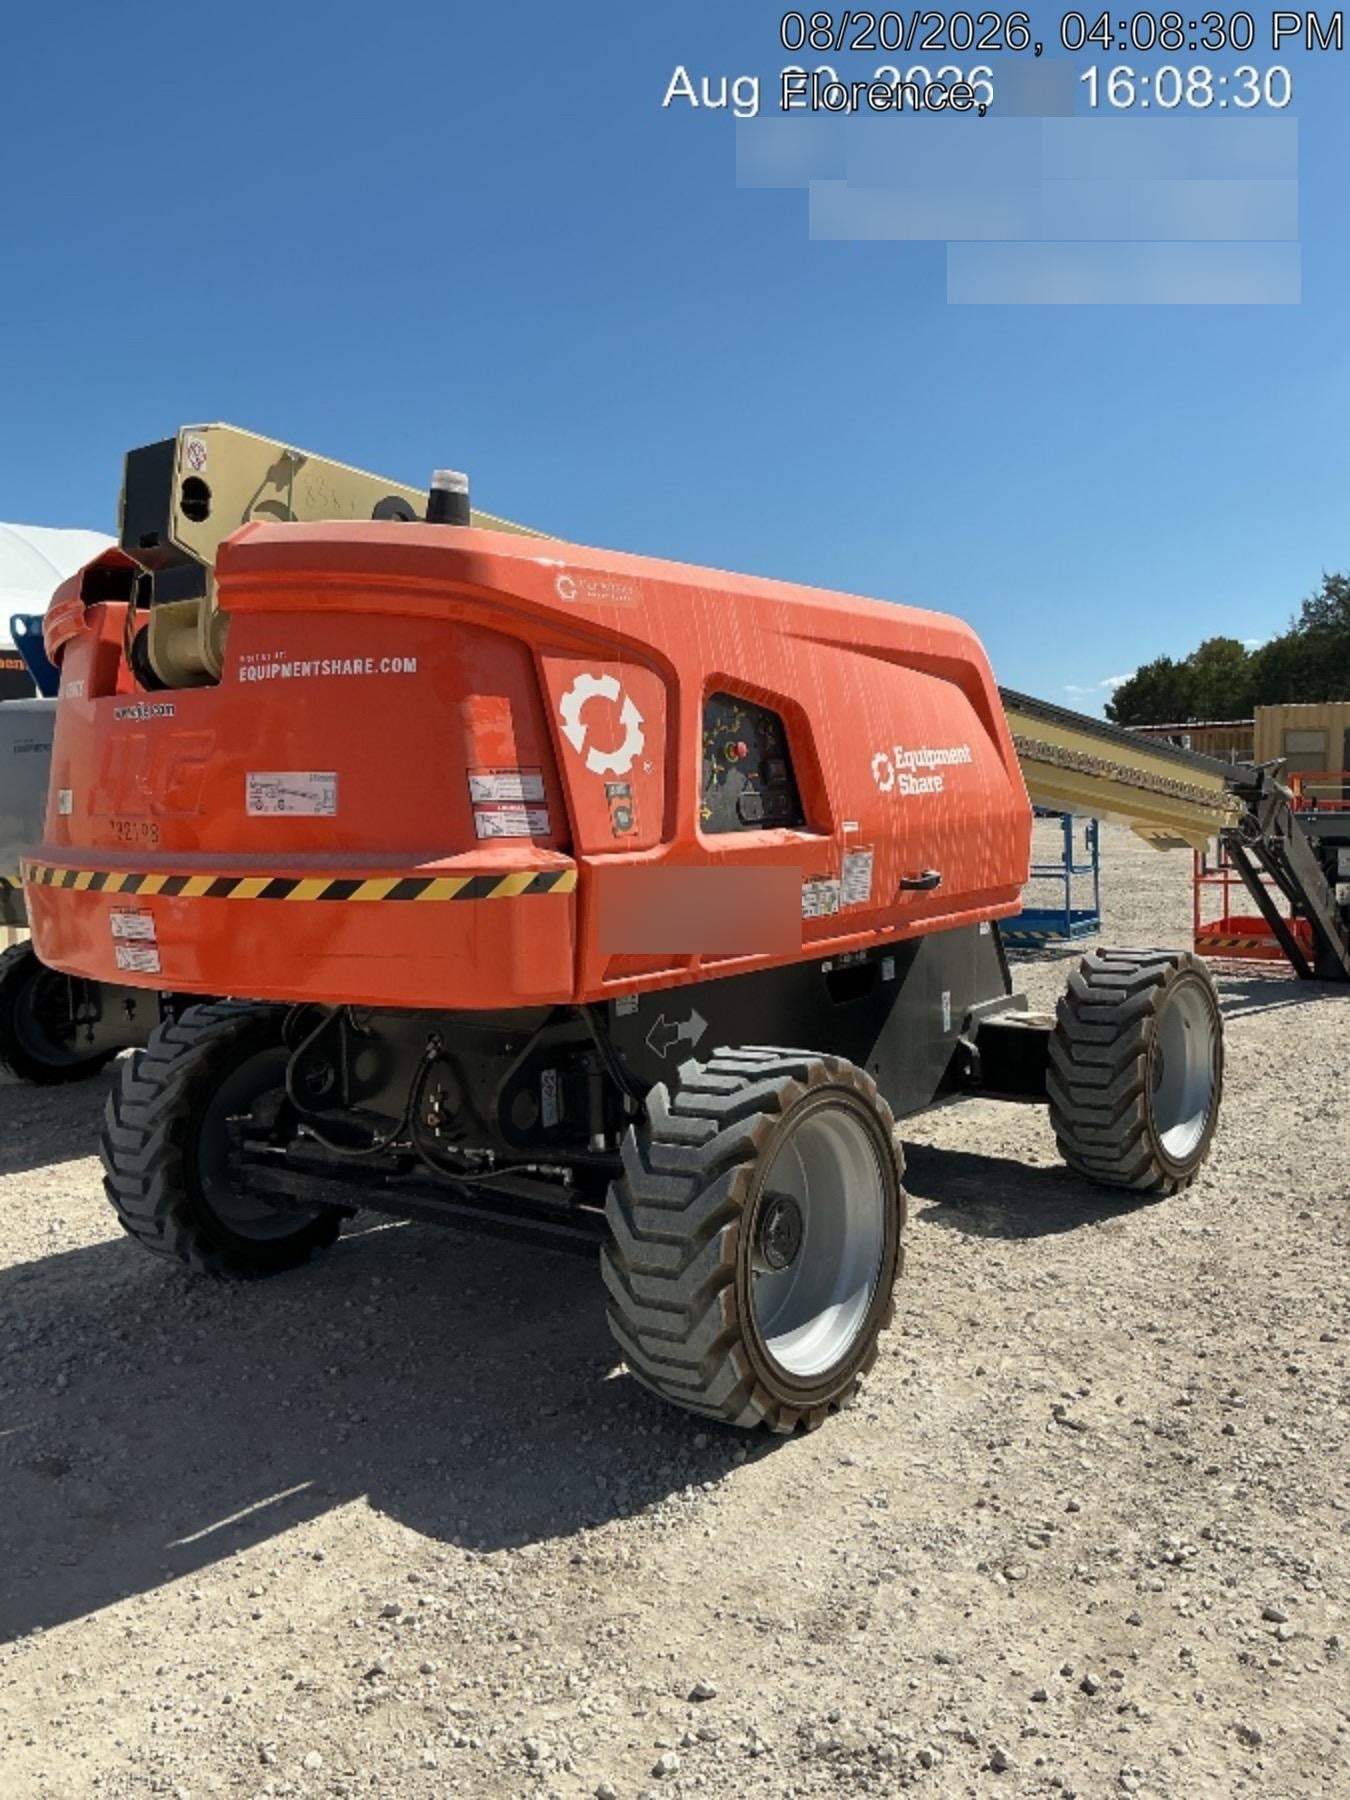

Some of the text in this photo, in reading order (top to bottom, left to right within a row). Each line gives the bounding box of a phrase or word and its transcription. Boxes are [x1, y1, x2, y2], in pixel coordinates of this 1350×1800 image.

[239, 657, 417, 683] EQUIPMENTSHARE.COM
[893, 744, 973, 773] Equipment
[898, 773, 944, 796] Share
